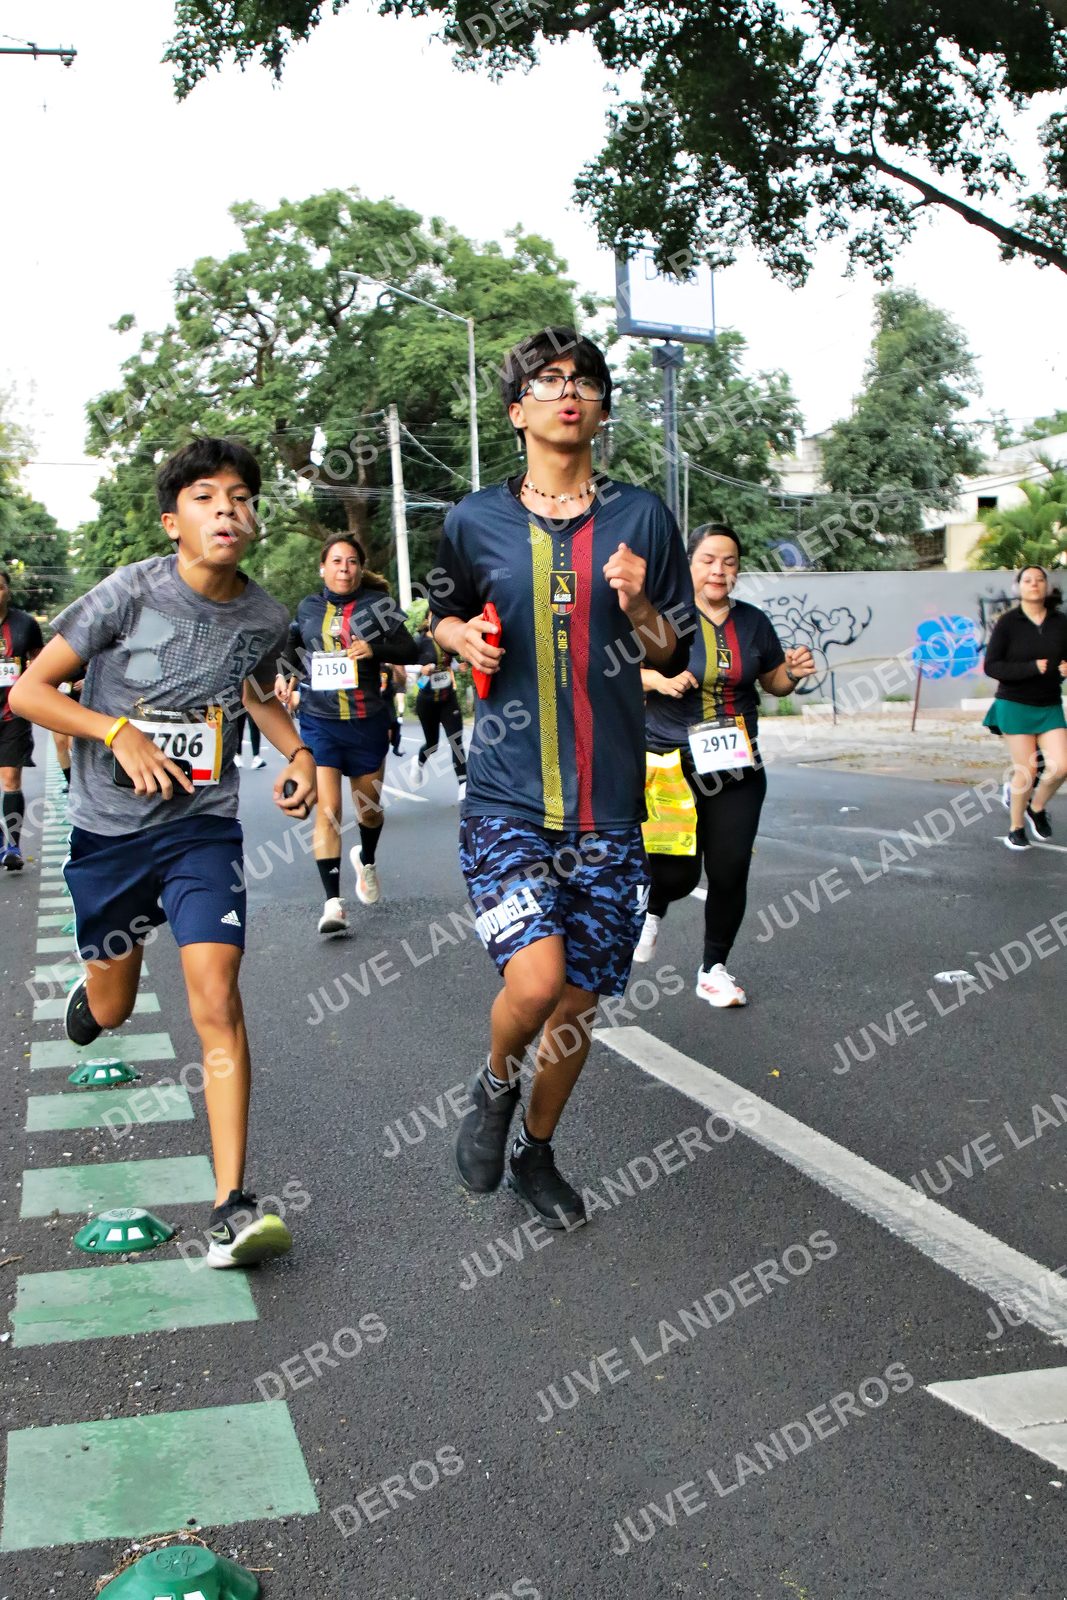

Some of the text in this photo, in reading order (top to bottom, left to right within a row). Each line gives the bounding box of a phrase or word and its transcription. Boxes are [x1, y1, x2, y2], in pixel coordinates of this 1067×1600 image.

[0, 667, 15, 676] 94
[317, 662, 347, 676] 2150
[700, 733, 738, 753] 2917
